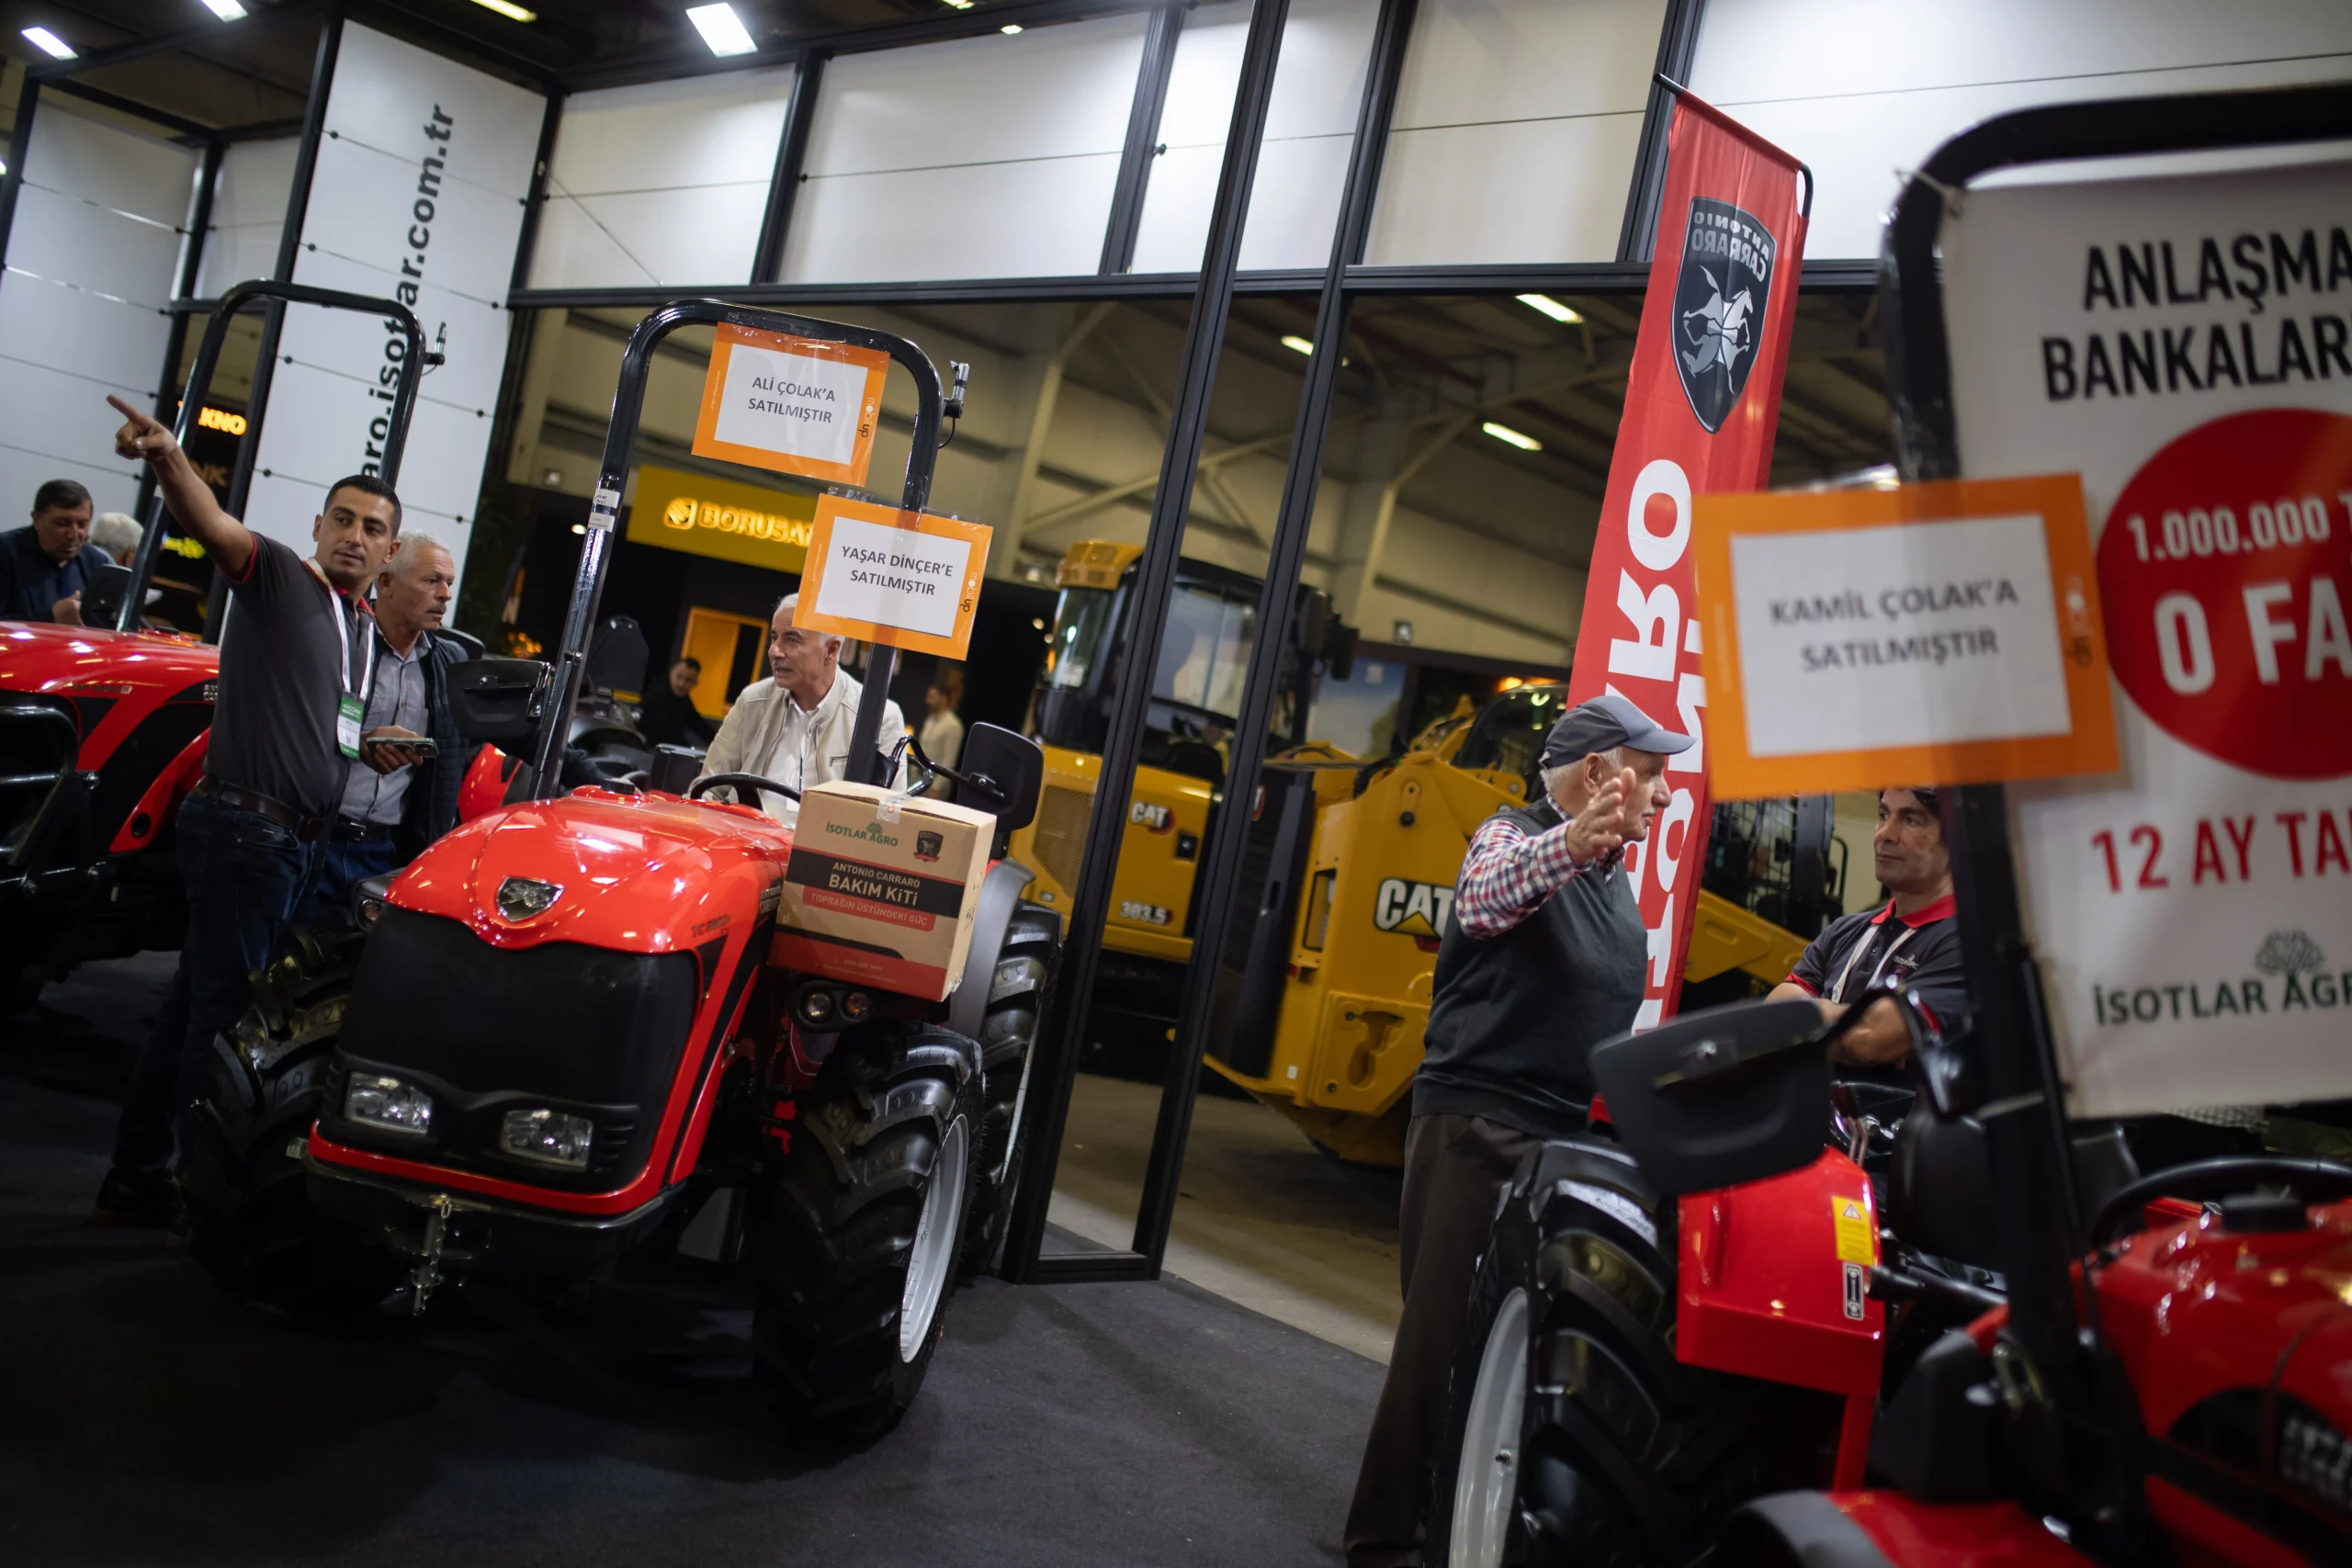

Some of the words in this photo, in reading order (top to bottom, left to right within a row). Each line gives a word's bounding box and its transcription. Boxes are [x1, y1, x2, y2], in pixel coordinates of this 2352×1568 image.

[2041, 312, 2352, 402] BANKALAR
[752, 377, 774, 391] ALİ
[748, 398, 832, 423] SATILMIŞTIR
[2127, 494, 2331, 563] 1.000.000
[842, 546, 887, 564] YAŞAR
[850, 570, 935, 595] SATILMIŞTIR
[1769, 589, 1873, 627] KAMİL
[1801, 628, 1999, 672] SATILMIŞTIR
[2153, 590, 2215, 697] 0
[1131, 802, 1169, 829] CAT
[869, 833, 899, 847] AGRO
[2091, 822, 2169, 895] 12
[2192, 815, 2256, 886] AY
[2275, 808, 2352, 879] TA
[829, 874, 882, 897] BAKIM
[832, 862, 875, 878] ANTONIO
[876, 872, 921, 888] CARRARO
[811, 893, 855, 909] TOPRAĞIN
[909, 915, 927, 927] GÜÇ
[1120, 901, 1167, 925] 303.5
[1376, 879, 1454, 939] CAT
